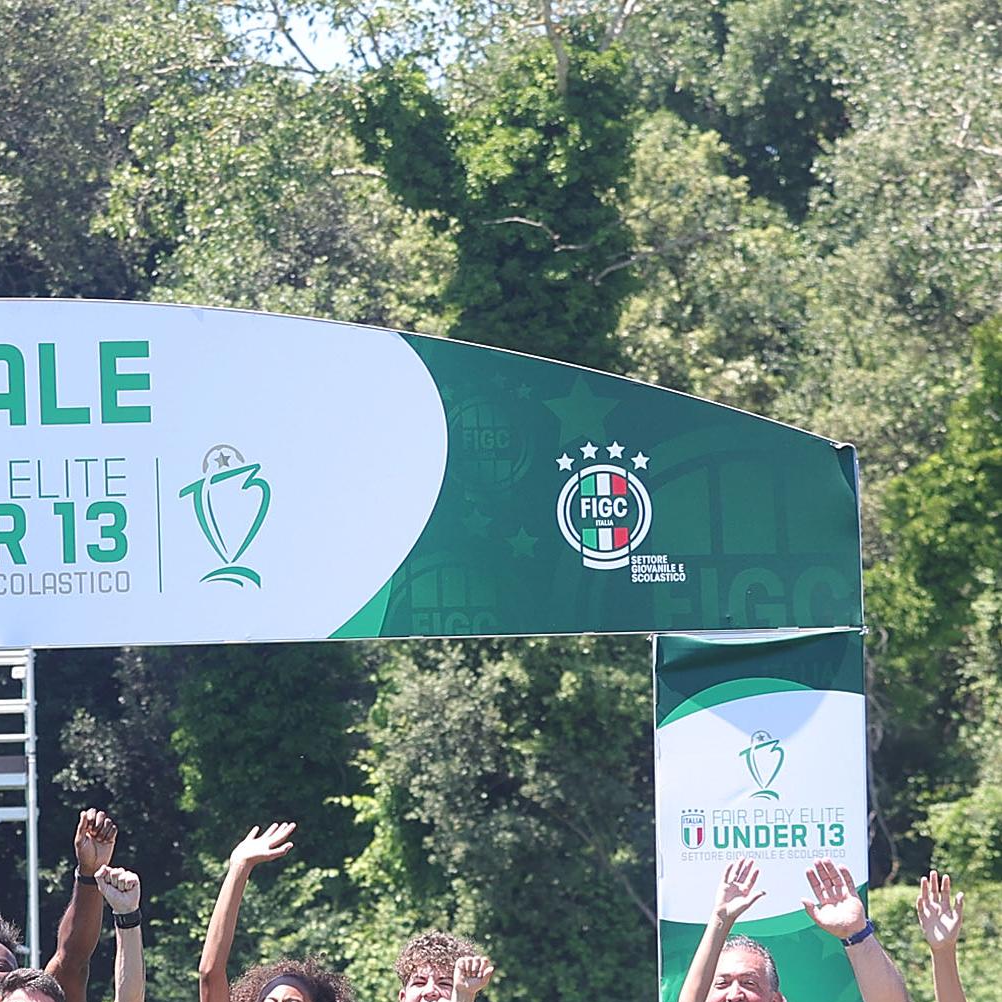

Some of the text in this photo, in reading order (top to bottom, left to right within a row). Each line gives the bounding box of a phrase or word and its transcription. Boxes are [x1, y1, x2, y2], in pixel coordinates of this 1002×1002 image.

[9, 458, 126, 499] ELITE
[580, 497, 628, 518] FIGC
[53, 501, 128, 564] 13
[631, 555, 668, 564] SETTORE
[631, 563, 684, 573] GIOVANILE E
[631, 573, 686, 582] SCOLASTICO
[712, 807, 845, 825] FAIR PLAY ELITE
[713, 823, 845, 849] UNDER 13
[681, 849, 846, 861] SETTORE GIOVANILE E SCOLASTICO
